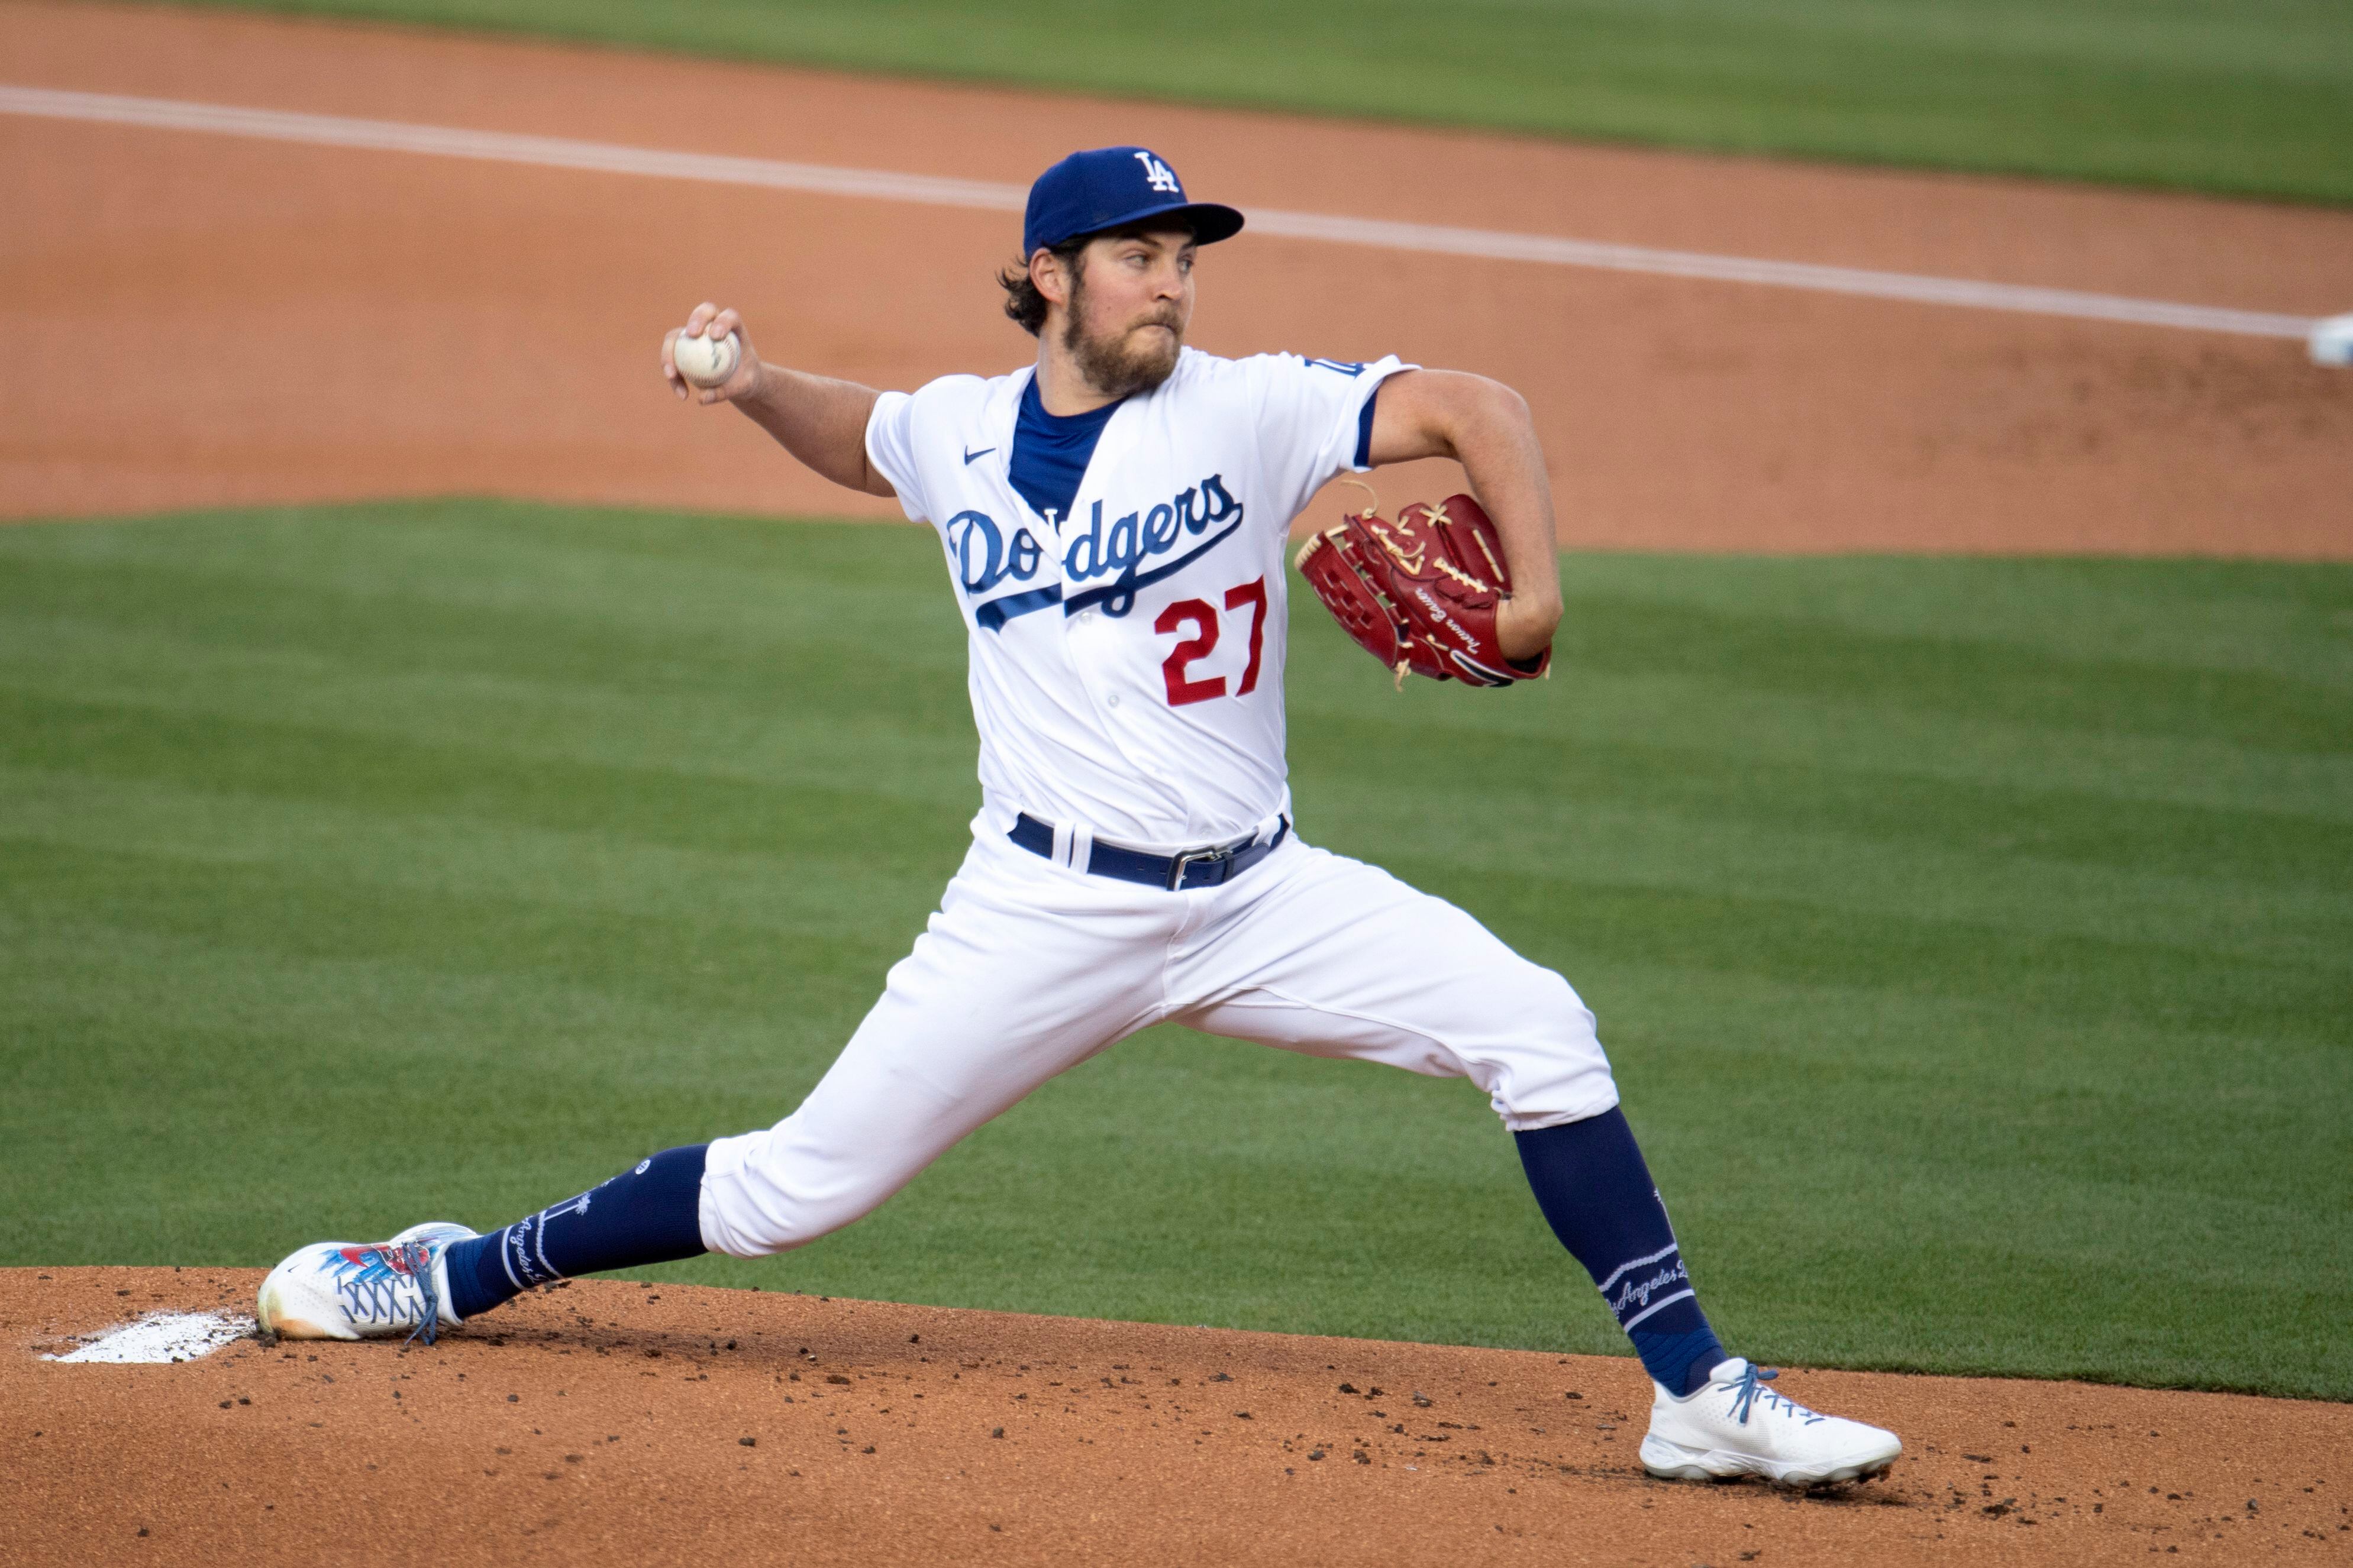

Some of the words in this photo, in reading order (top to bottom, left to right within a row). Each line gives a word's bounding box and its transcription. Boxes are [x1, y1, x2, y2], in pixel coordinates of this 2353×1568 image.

[1134, 151, 1179, 193] LA
[947, 474, 1243, 619] Dodgers
[1415, 587, 1447, 623] Bauer
[1154, 574, 1267, 707] 27
[1446, 619, 1480, 654] Trevor
[1618, 1269, 1677, 1310] Angeles
